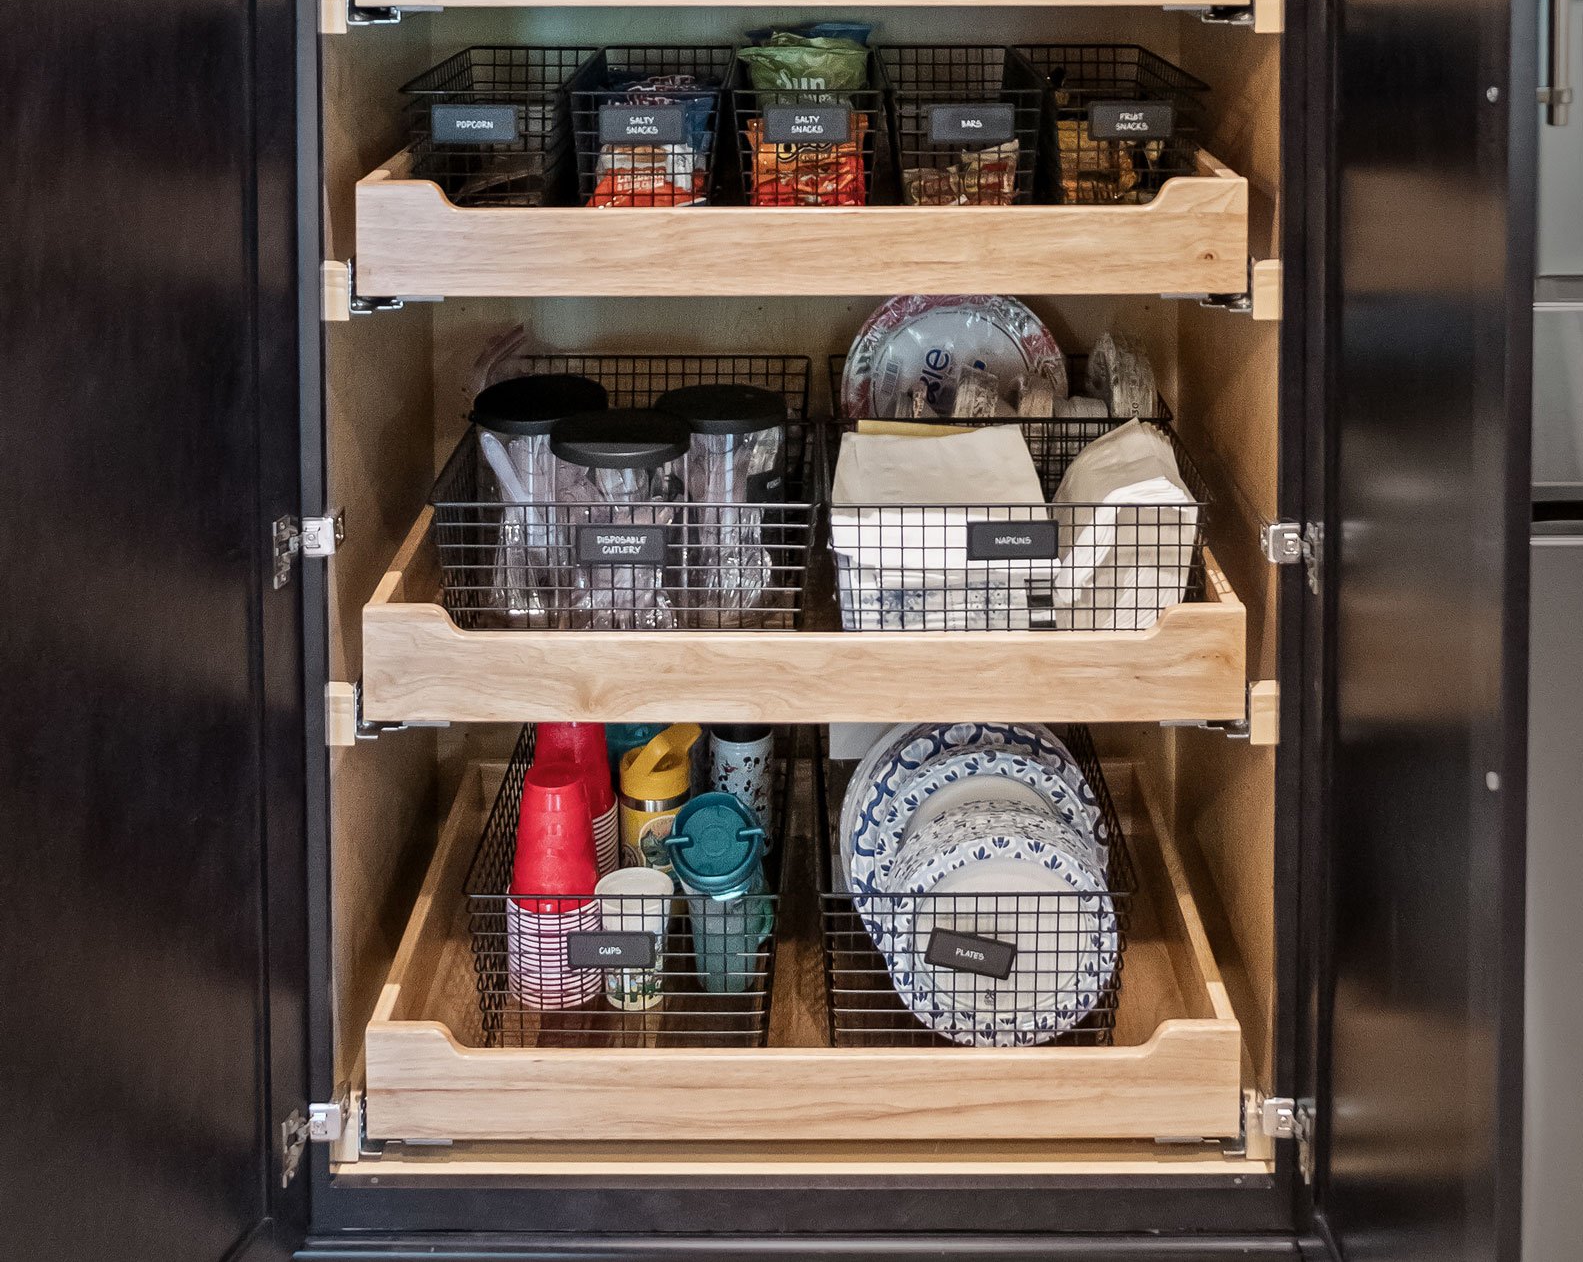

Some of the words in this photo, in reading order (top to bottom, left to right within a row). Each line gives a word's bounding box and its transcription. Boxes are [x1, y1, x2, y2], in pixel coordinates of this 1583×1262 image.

[630, 117, 655, 125] SALTY
[794, 115, 820, 124] SALTY
[456, 120, 494, 128] POPCORN
[961, 120, 983, 128] BARS
[1115, 122, 1149, 130] SNACKS
[626, 126, 659, 134] SNACKS
[791, 125, 824, 133] SNACKS
[596, 535, 648, 544] DISPOSABLE
[994, 536, 1032, 544] NAPKINS
[602, 545, 641, 554] CUTLERY
[599, 946, 622, 954] CUPS
[955, 947, 985, 960] PLATES
